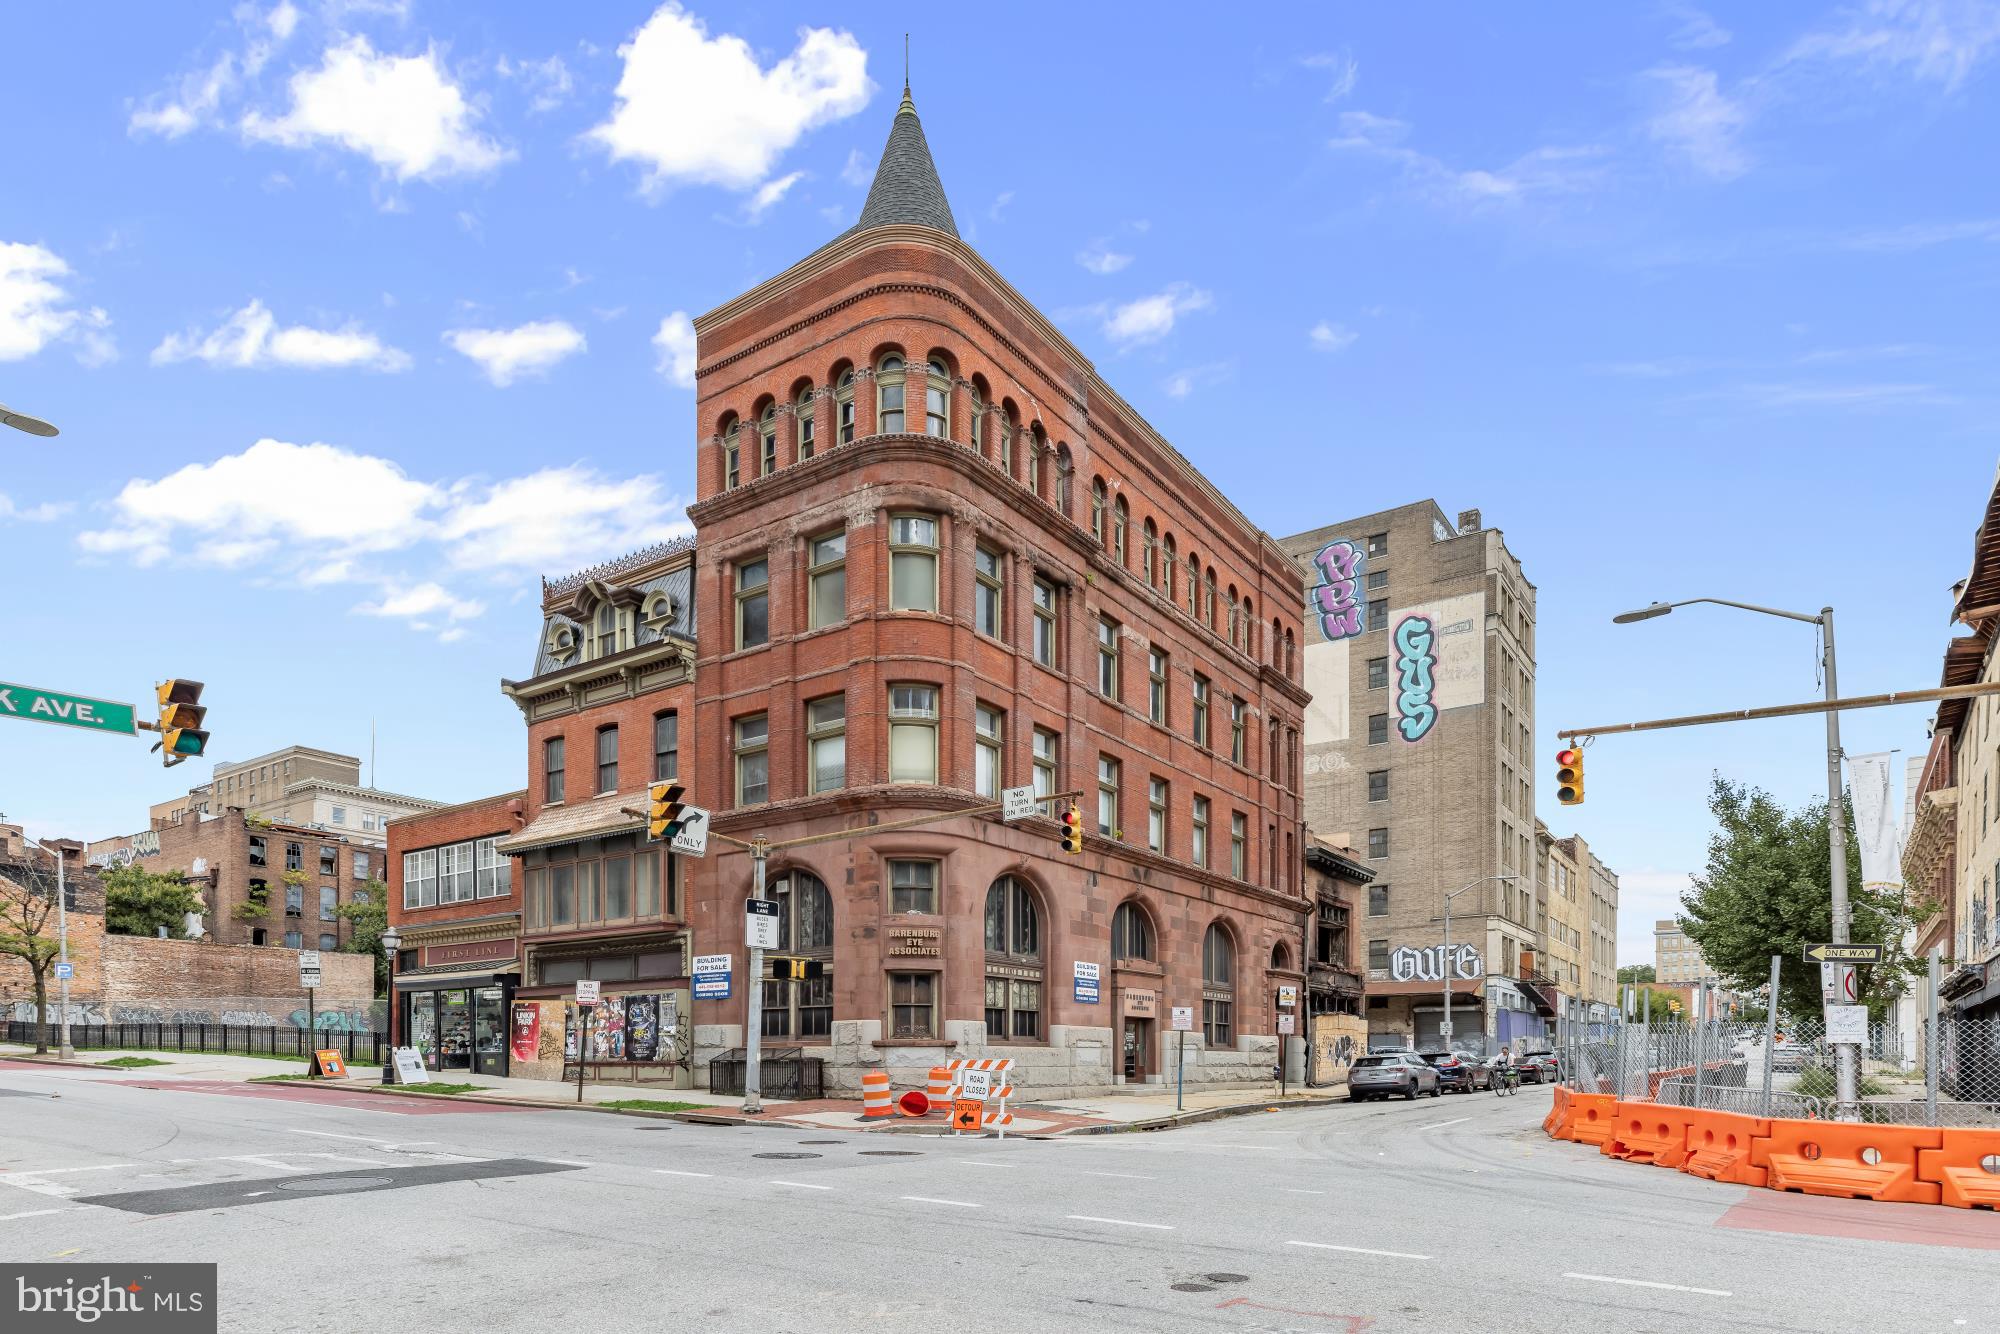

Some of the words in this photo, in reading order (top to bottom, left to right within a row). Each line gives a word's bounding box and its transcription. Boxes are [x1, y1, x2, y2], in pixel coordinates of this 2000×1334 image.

[31, 696, 104, 724] AVE.
[1013, 790, 1025, 798] NO
[1010, 798, 1029, 807] TURN
[1005, 809, 1016, 817] ON
[1020, 805, 1034, 814] RED
[677, 835, 702, 848] ONLY
[888, 929, 941, 938] BARENBURG
[906, 938, 924, 946] EYE
[888, 946, 941, 956] ASSOCIATES
[1825, 949, 1846, 957] ONE
[1849, 949, 1873, 957] WAY
[696, 956, 727, 964] BUILDING
[57, 965, 71, 976] P
[710, 963, 728, 971] SALE
[517, 1018, 533, 1026] PARK
[969, 1075, 985, 1083] ROAD
[965, 1086, 987, 1095] CLOSED
[956, 1103, 981, 1111] DETOUR
